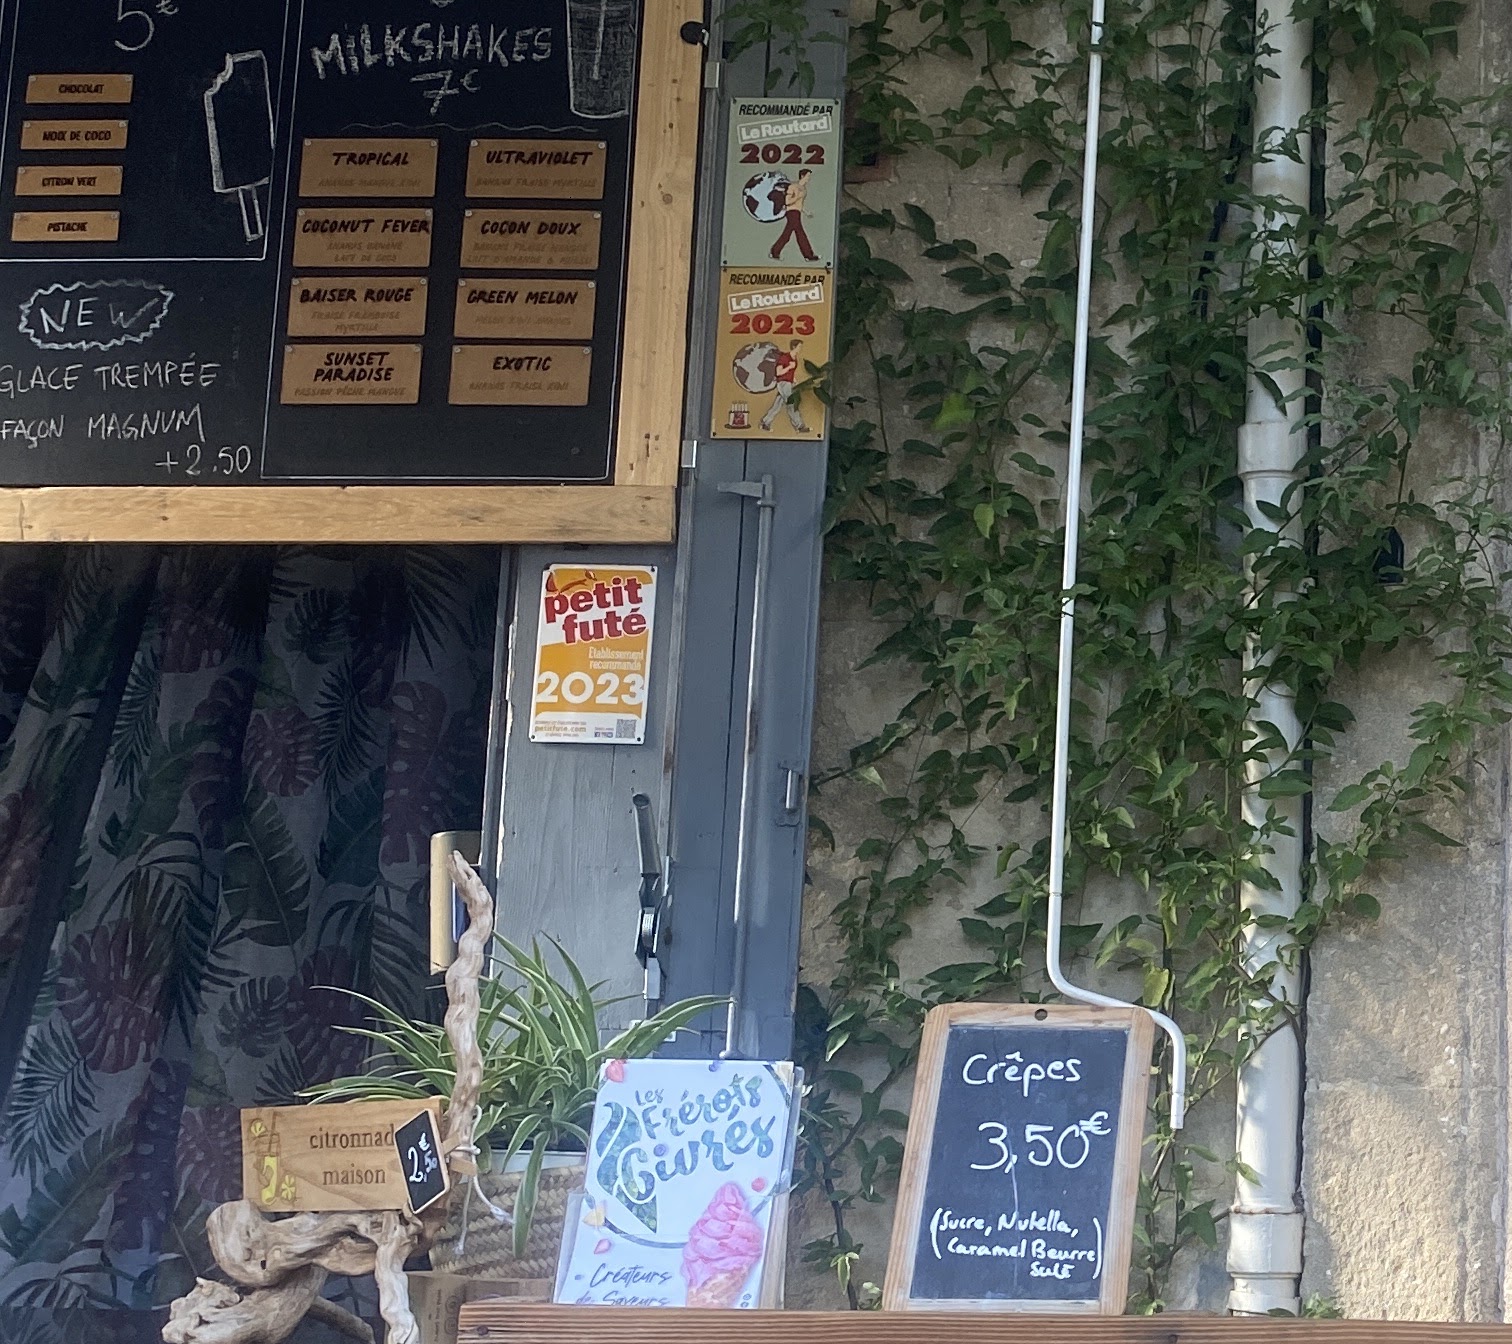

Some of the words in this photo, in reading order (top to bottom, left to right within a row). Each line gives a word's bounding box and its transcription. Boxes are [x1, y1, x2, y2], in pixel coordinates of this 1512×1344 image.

[310, 22, 552, 80] MILKSHAKES
[59, 84, 104, 94] CHOCOLAT
[739, 103, 810, 116] RECOMMANDÉ
[812, 105, 833, 116] PAR
[85, 130, 111, 141] COCO
[741, 127, 760, 140] Le
[762, 116, 828, 137] Routard
[333, 152, 409, 166] TROPICAL
[486, 150, 593, 166] ULTRAVIOLET
[739, 143, 825, 165] 2022
[302, 219, 374, 234] COCONUT
[382, 220, 429, 234] FEVER
[480, 220, 531, 235] COCON
[538, 221, 581, 235] DOUX
[729, 273, 801, 285] RECOMMANDÉ
[804, 275, 825, 286] PAR
[300, 288, 357, 303] BAISER
[364, 288, 414, 303] ROUGE
[467, 290, 518, 305] GREEN
[525, 291, 578, 305] MELON
[731, 297, 750, 310] Le
[752, 286, 820, 308] Routard
[40, 297, 160, 335] NEW
[730, 314, 815, 335] 2023
[324, 352, 390, 367] SUNSET
[493, 356, 552, 372] EXOTIC
[0, 364, 83, 398] GLACE
[94, 353, 221, 391] TREMPÉE
[313, 367, 394, 382] PARADISE
[1, 414, 64, 449] FAÇON
[88, 403, 205, 443] MAGNUM
[544, 577, 643, 624] petit
[562, 608, 647, 644] futé
[536, 671, 644, 705] 2023
[962, 1051, 1082, 1097] Crêpes
[635, 1088, 664, 1107] Les
[310, 1123, 395, 1149] citronnad
[323, 1163, 386, 1186] maison
[947, 1233, 1027, 1258] Caramel
[590, 1263, 672, 1288] Créateurs
